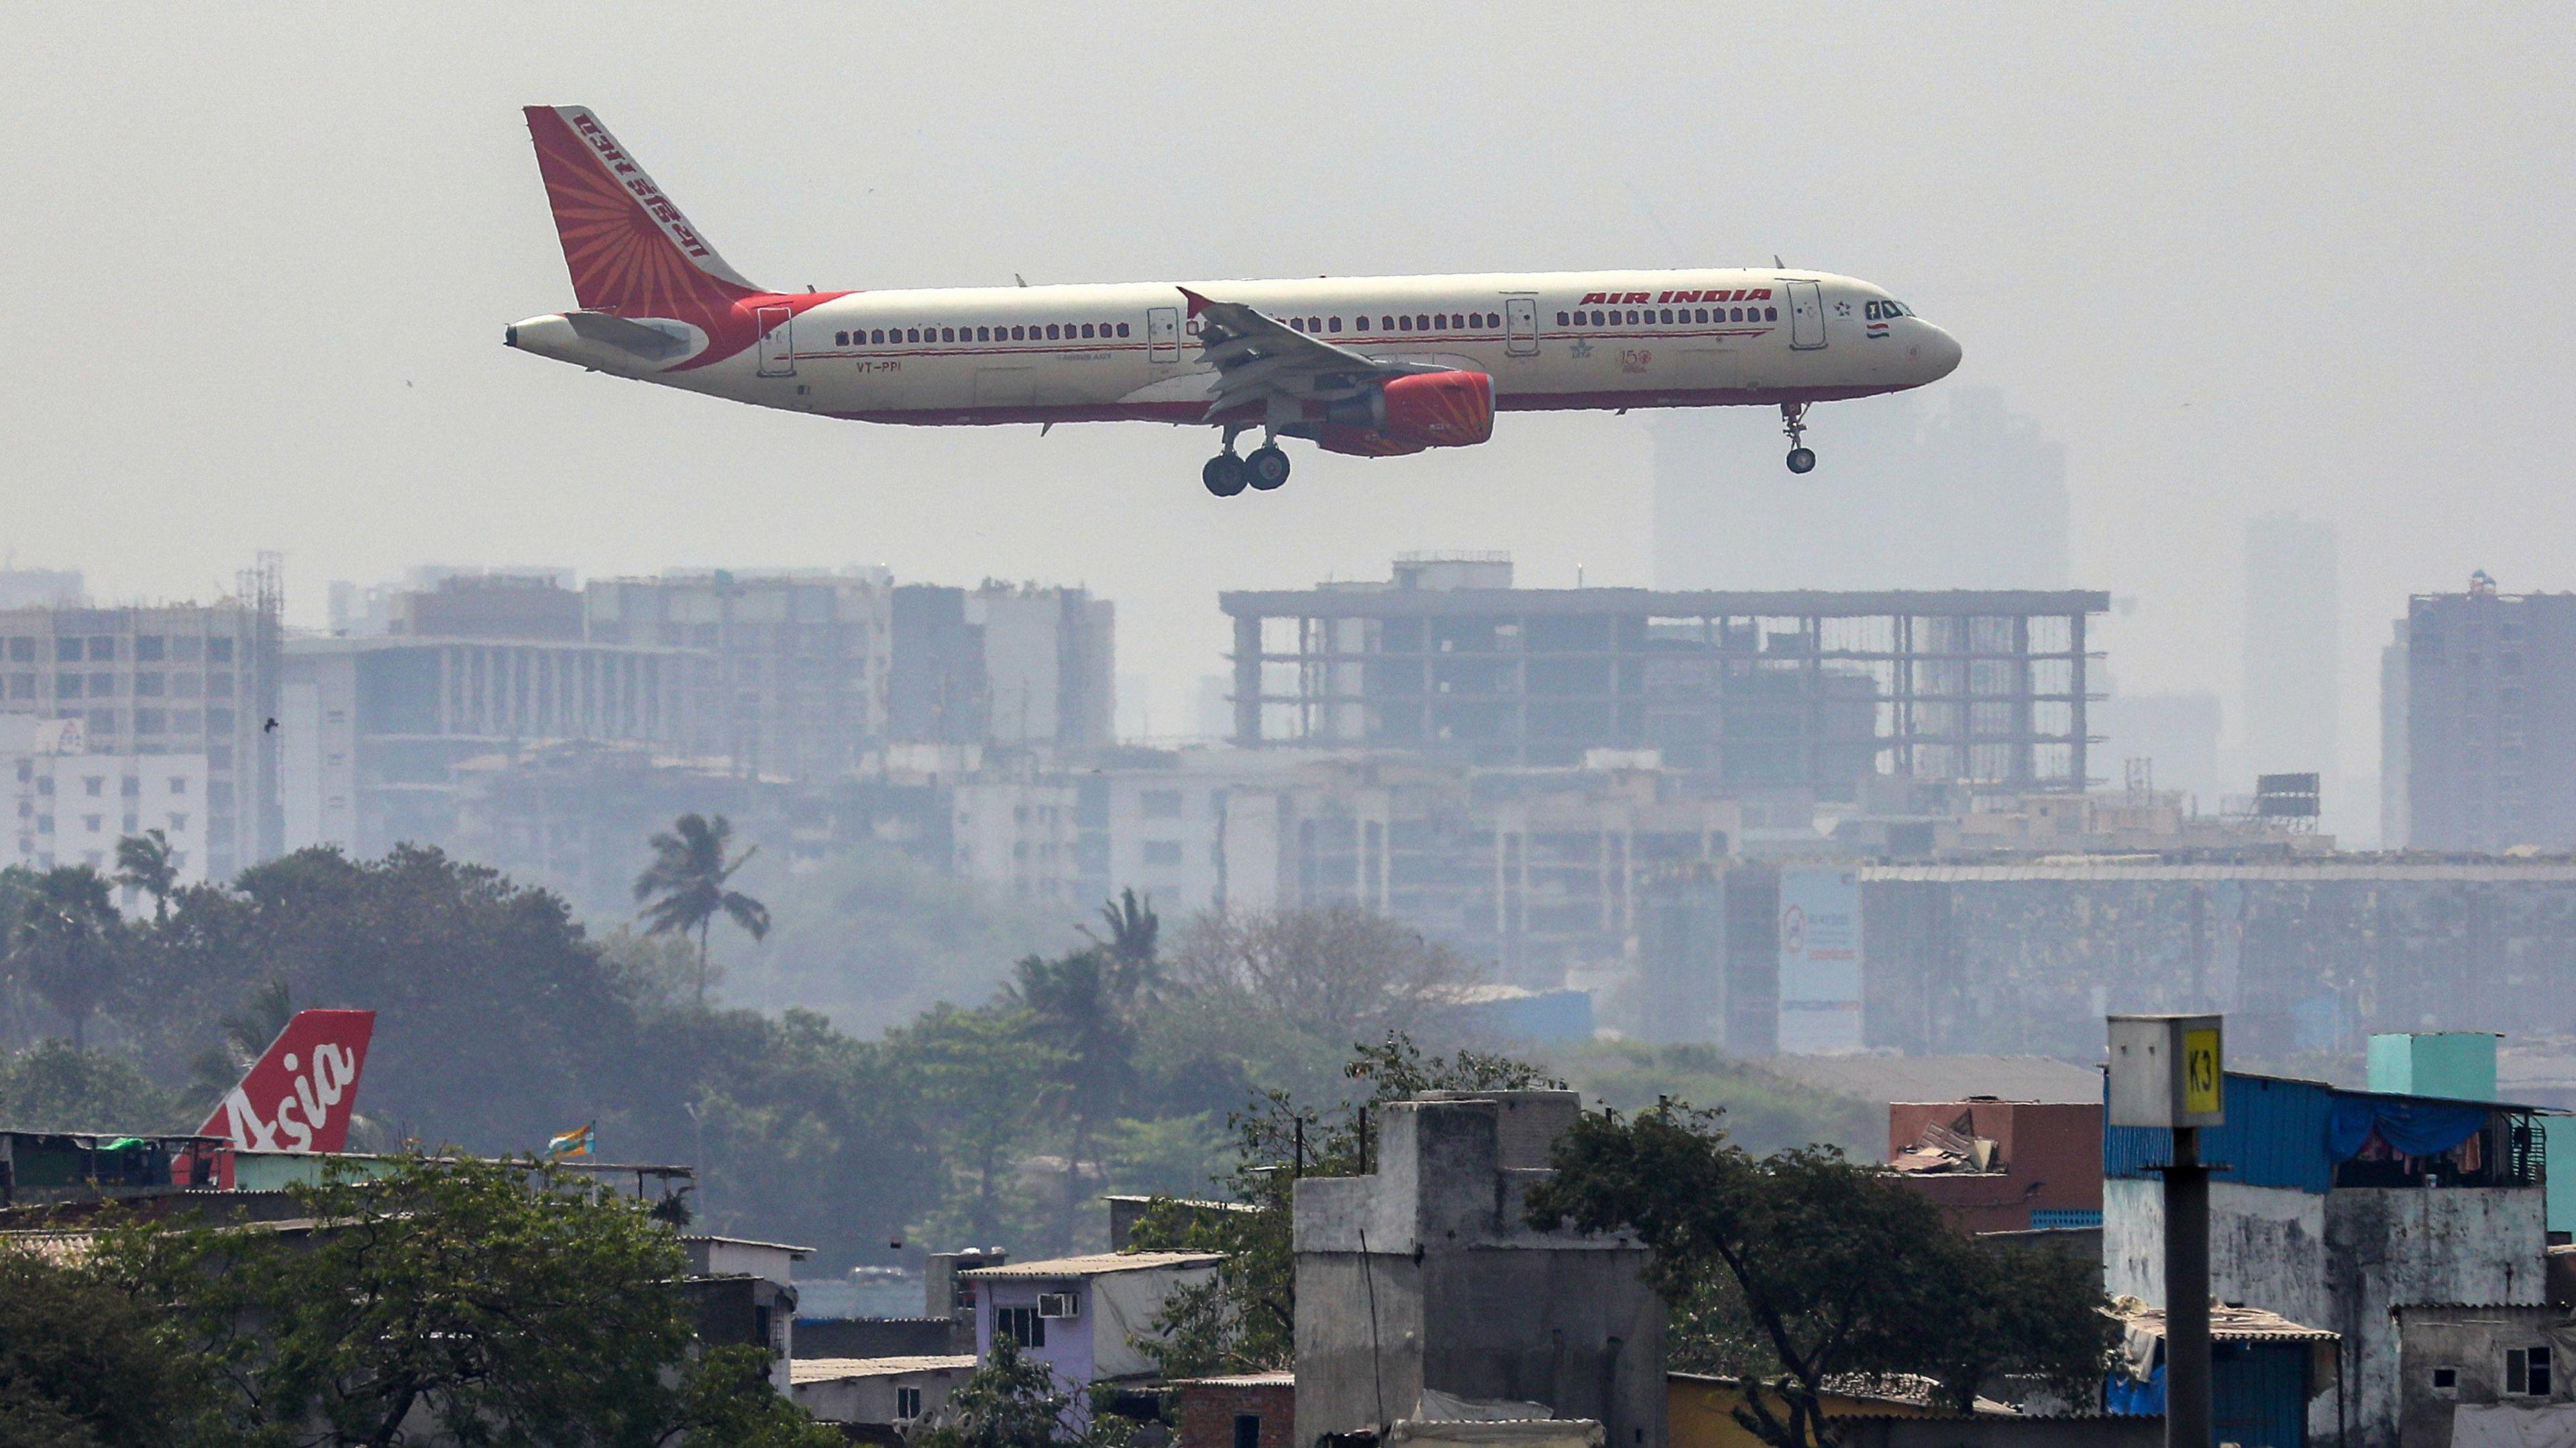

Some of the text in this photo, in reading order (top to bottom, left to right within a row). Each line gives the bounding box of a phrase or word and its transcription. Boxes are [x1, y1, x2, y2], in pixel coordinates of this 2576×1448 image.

[1579, 288, 1772, 305] AIR INDIA
[856, 361, 901, 373] VT-PPI
[2190, 1050, 2212, 1093] K3
[225, 1043, 355, 1152] Asia
